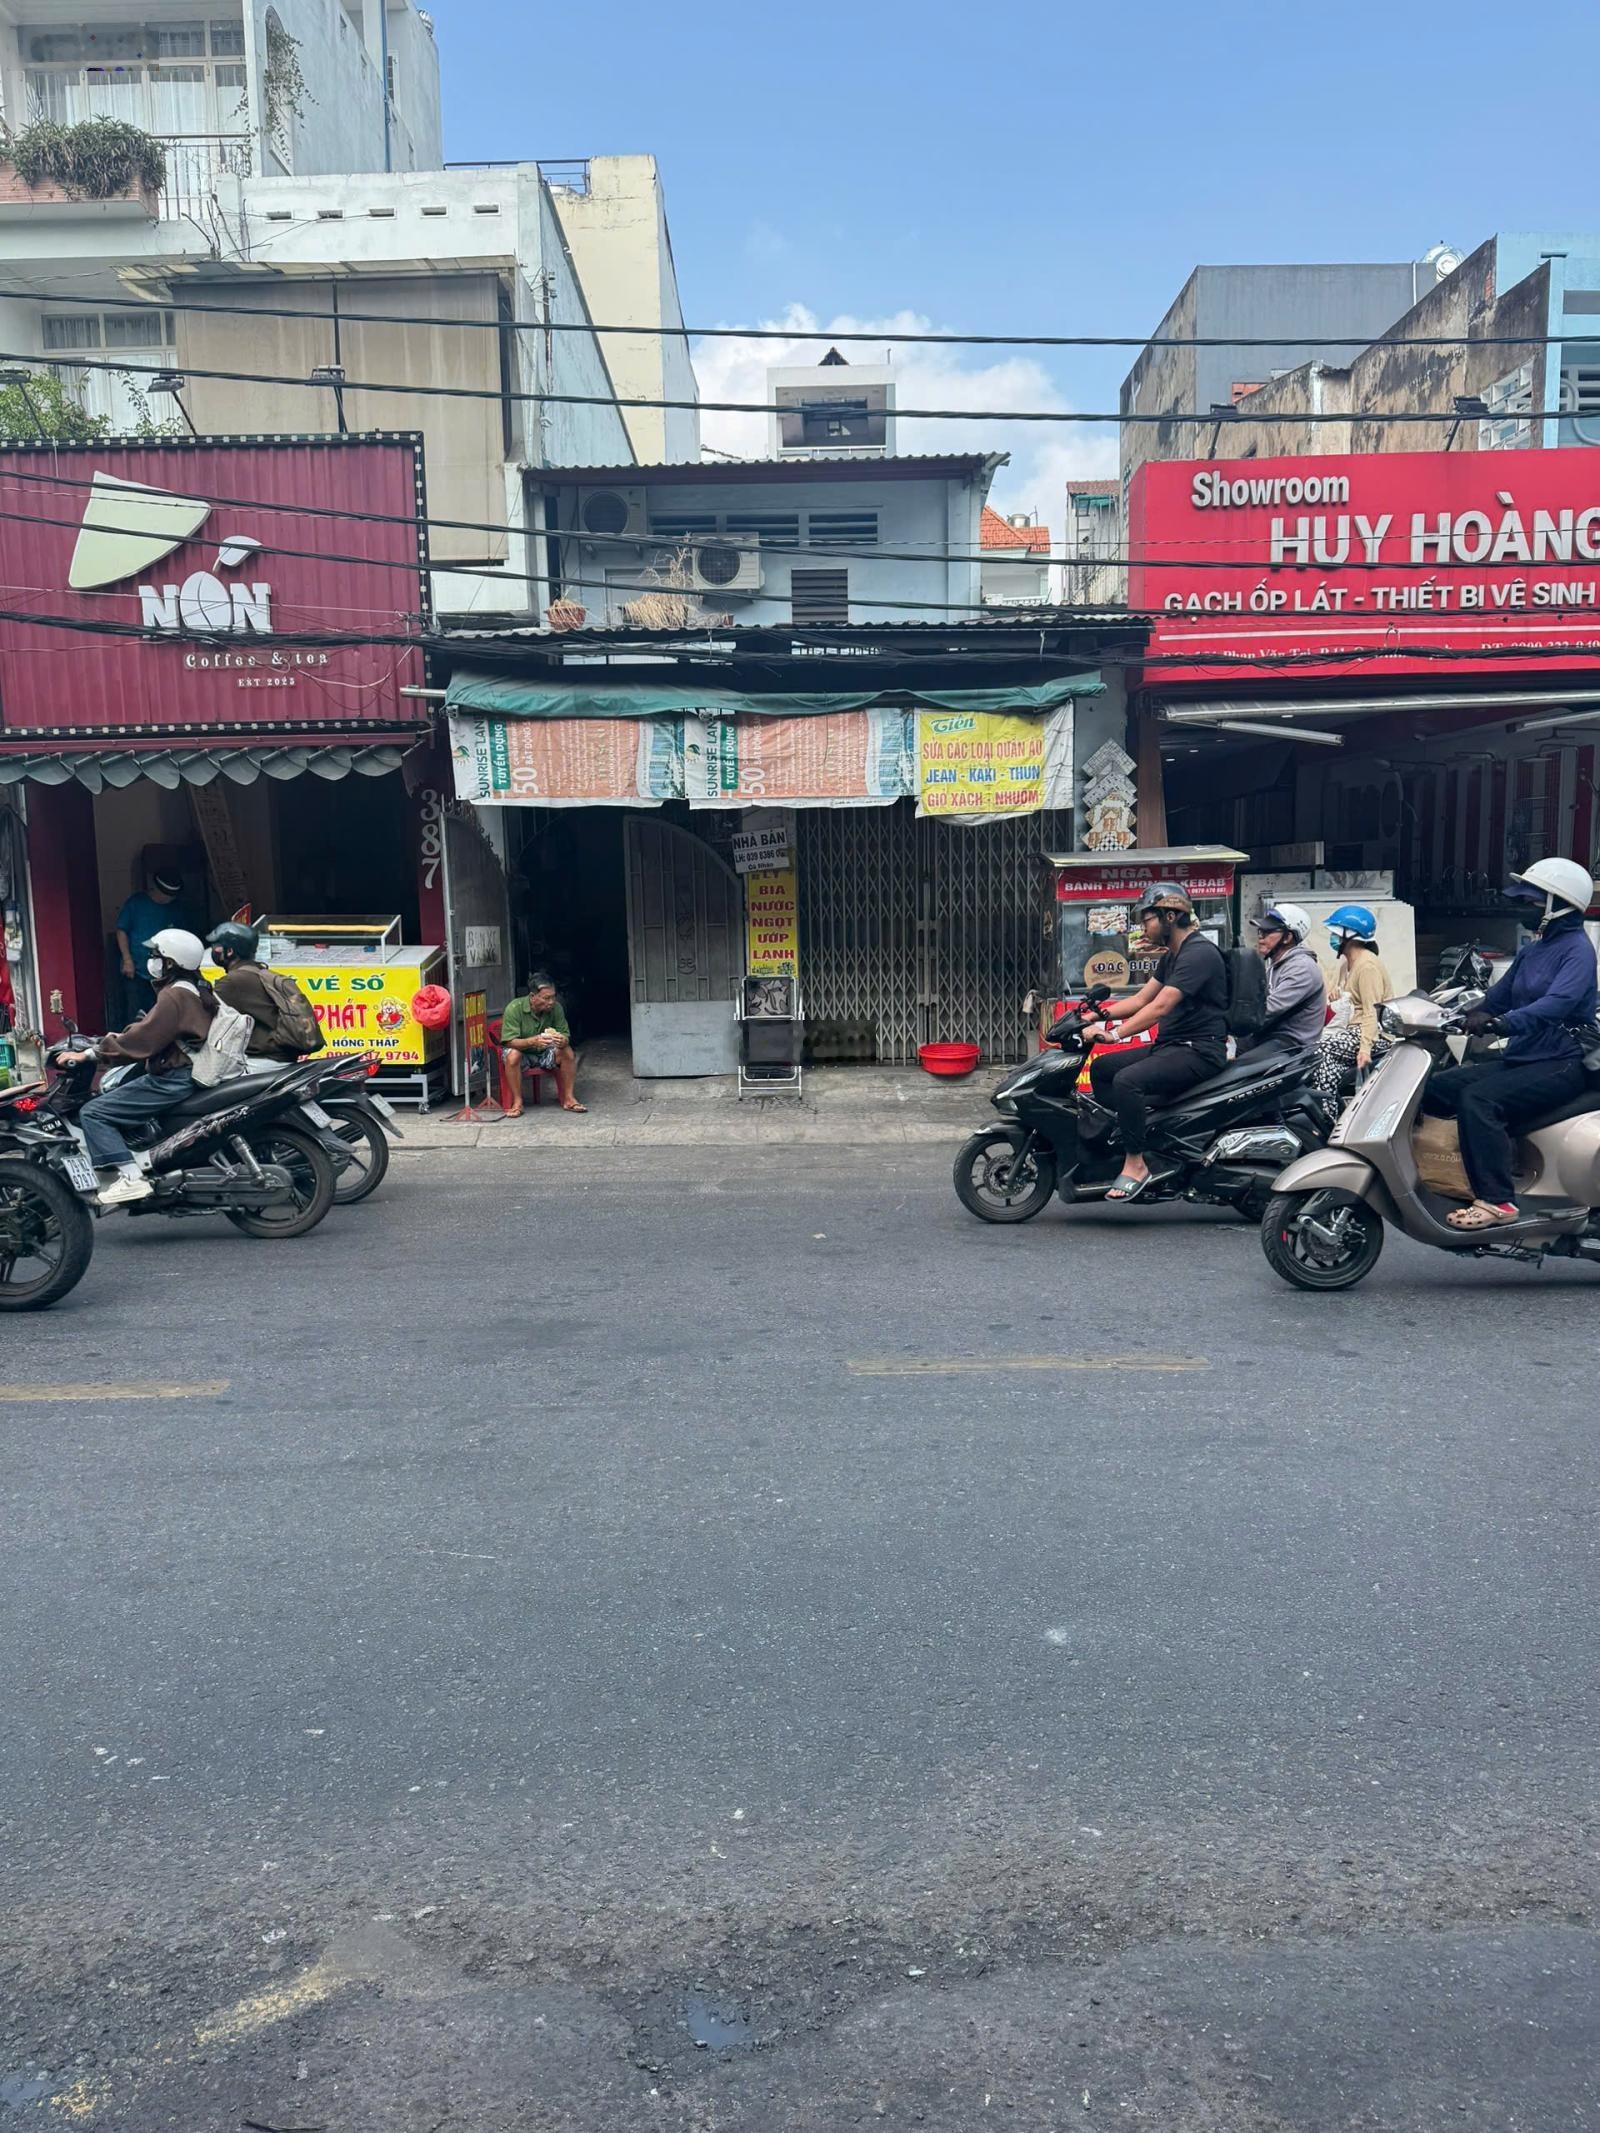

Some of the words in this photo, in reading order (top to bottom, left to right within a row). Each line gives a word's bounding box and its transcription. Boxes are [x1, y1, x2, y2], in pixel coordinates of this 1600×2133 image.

[1191, 471, 1350, 507] Showroom
[1271, 513, 1394, 565] HUY
[1411, 491, 1600, 563] HOÀNG
[1249, 577, 1288, 612] ỐP
[1294, 580, 1348, 612] LÁT
[1370, 575, 1454, 609] THIẾT
[1532, 581, 1597, 606] SINH
[185, 653, 256, 668] Coffee
[295, 652, 328, 665] tea
[238, 677, 260, 687] EST
[493, 724, 507, 752] DỤNG
[726, 726, 736, 752] DỤNG
[923, 737, 944, 760] SỬA
[947, 738, 968, 760] CÁC
[971, 741, 993, 763] LOẠI
[1029, 736, 1042, 756] ÁO
[475, 747, 491, 798] SUNRISE
[491, 753, 507, 785] TUYỂN
[706, 747, 718, 797] SUNRISE
[722, 753, 735, 784] TUYỂN
[926, 768, 957, 783] JEAN
[969, 767, 997, 782] KAKI
[1008, 765, 1041, 781] THUN
[512, 766, 539, 794] 50
[740, 766, 766, 794] 50
[951, 790, 983, 807] XÁCH
[995, 788, 1039, 807] NHUỘM
[733, 832, 758, 849] NHÀ
[760, 830, 786, 846] BÁN
[1101, 866, 1153, 879] NGA
[1162, 864, 1190, 878] LÊ
[759, 885, 786, 895] BIA
[1065, 879, 1103, 891] BÁNH
[1107, 879, 1126, 890] MÌ
[752, 899, 795, 912] NƯỚC
[752, 917, 794, 930] NGỌT
[757, 931, 789, 944] ƯỚP
[752, 949, 795, 962] LẠNH
[1129, 956, 1160, 974] BIỆT
[308, 971, 340, 991] VÉ
[350, 972, 386, 991] SỐ
[385, 1051, 419, 1061] 9794
